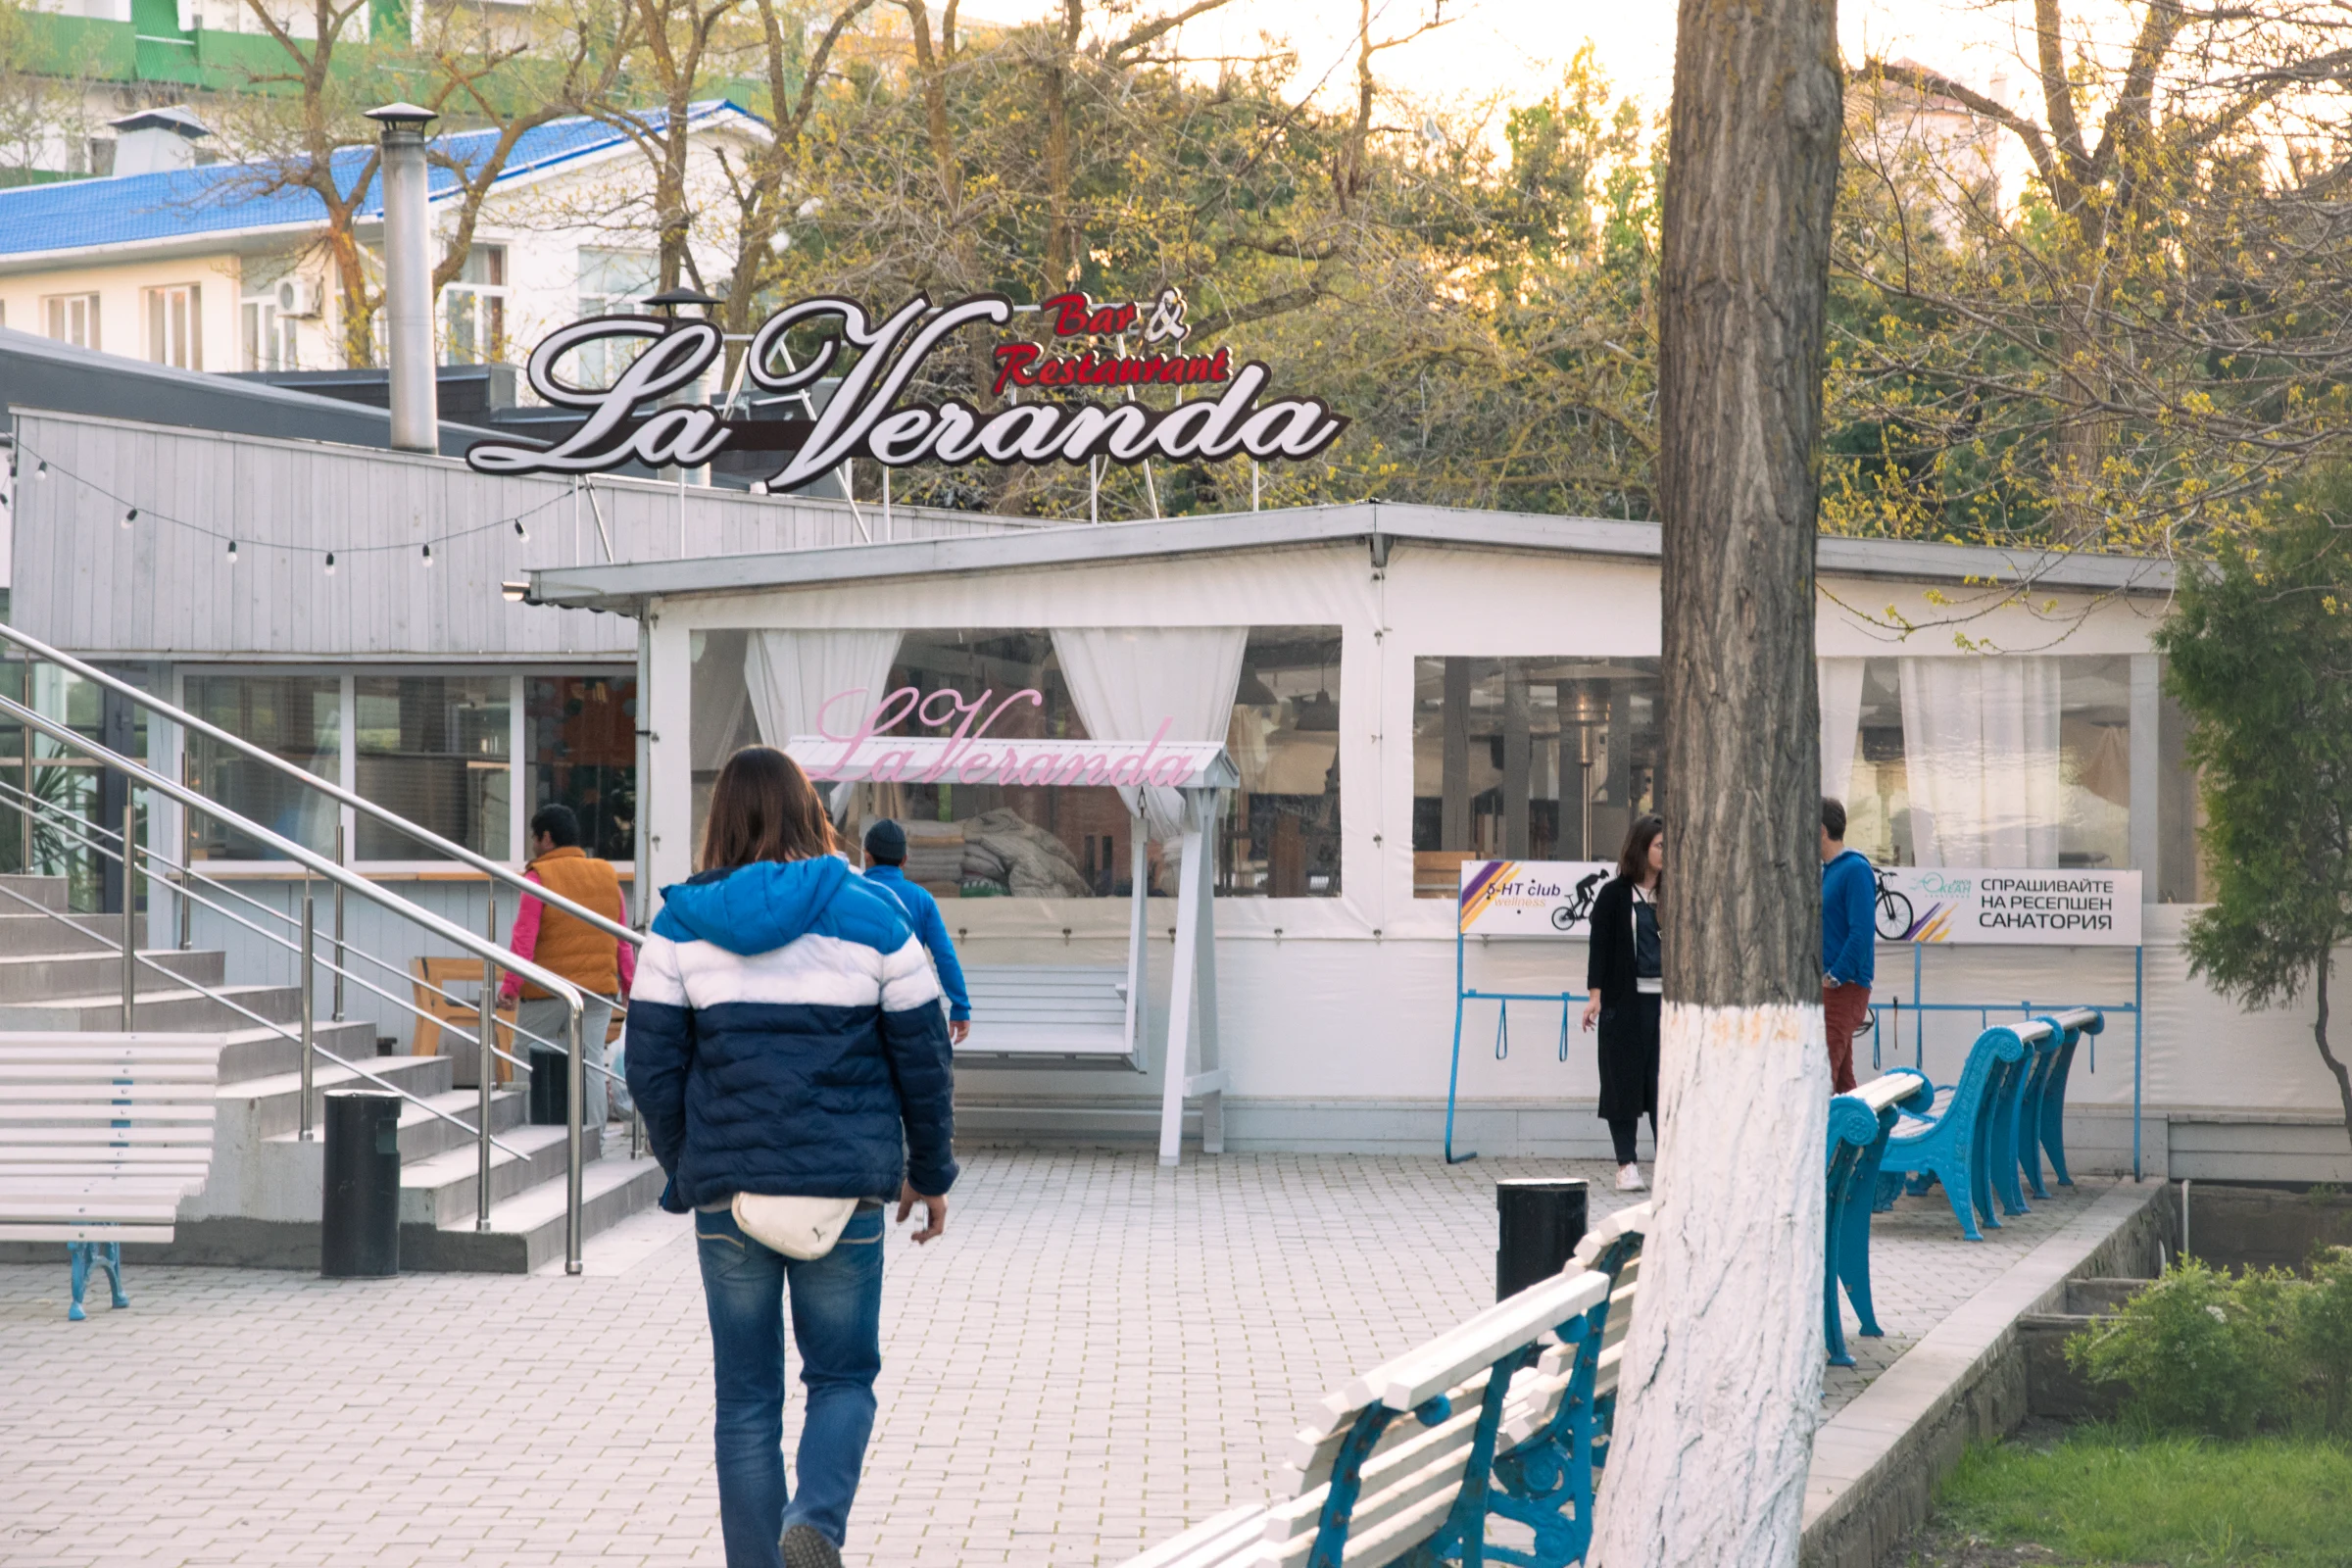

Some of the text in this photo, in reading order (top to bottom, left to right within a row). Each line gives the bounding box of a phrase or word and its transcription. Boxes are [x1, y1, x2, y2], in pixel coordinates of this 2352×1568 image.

[1042, 286, 1190, 343] Bar &
[993, 340, 1233, 396] Restaurant
[466, 288, 1349, 492] La Veranda
[1486, 882, 1561, 896] 5-HT club
[1981, 877, 2114, 894] СПРАШИВАЙТЕ
[1494, 896, 1546, 907] wellness
[1982, 895, 2113, 910] НА РЕСЕПШЕН
[1979, 911, 2113, 930] САНАТОРИЯ
